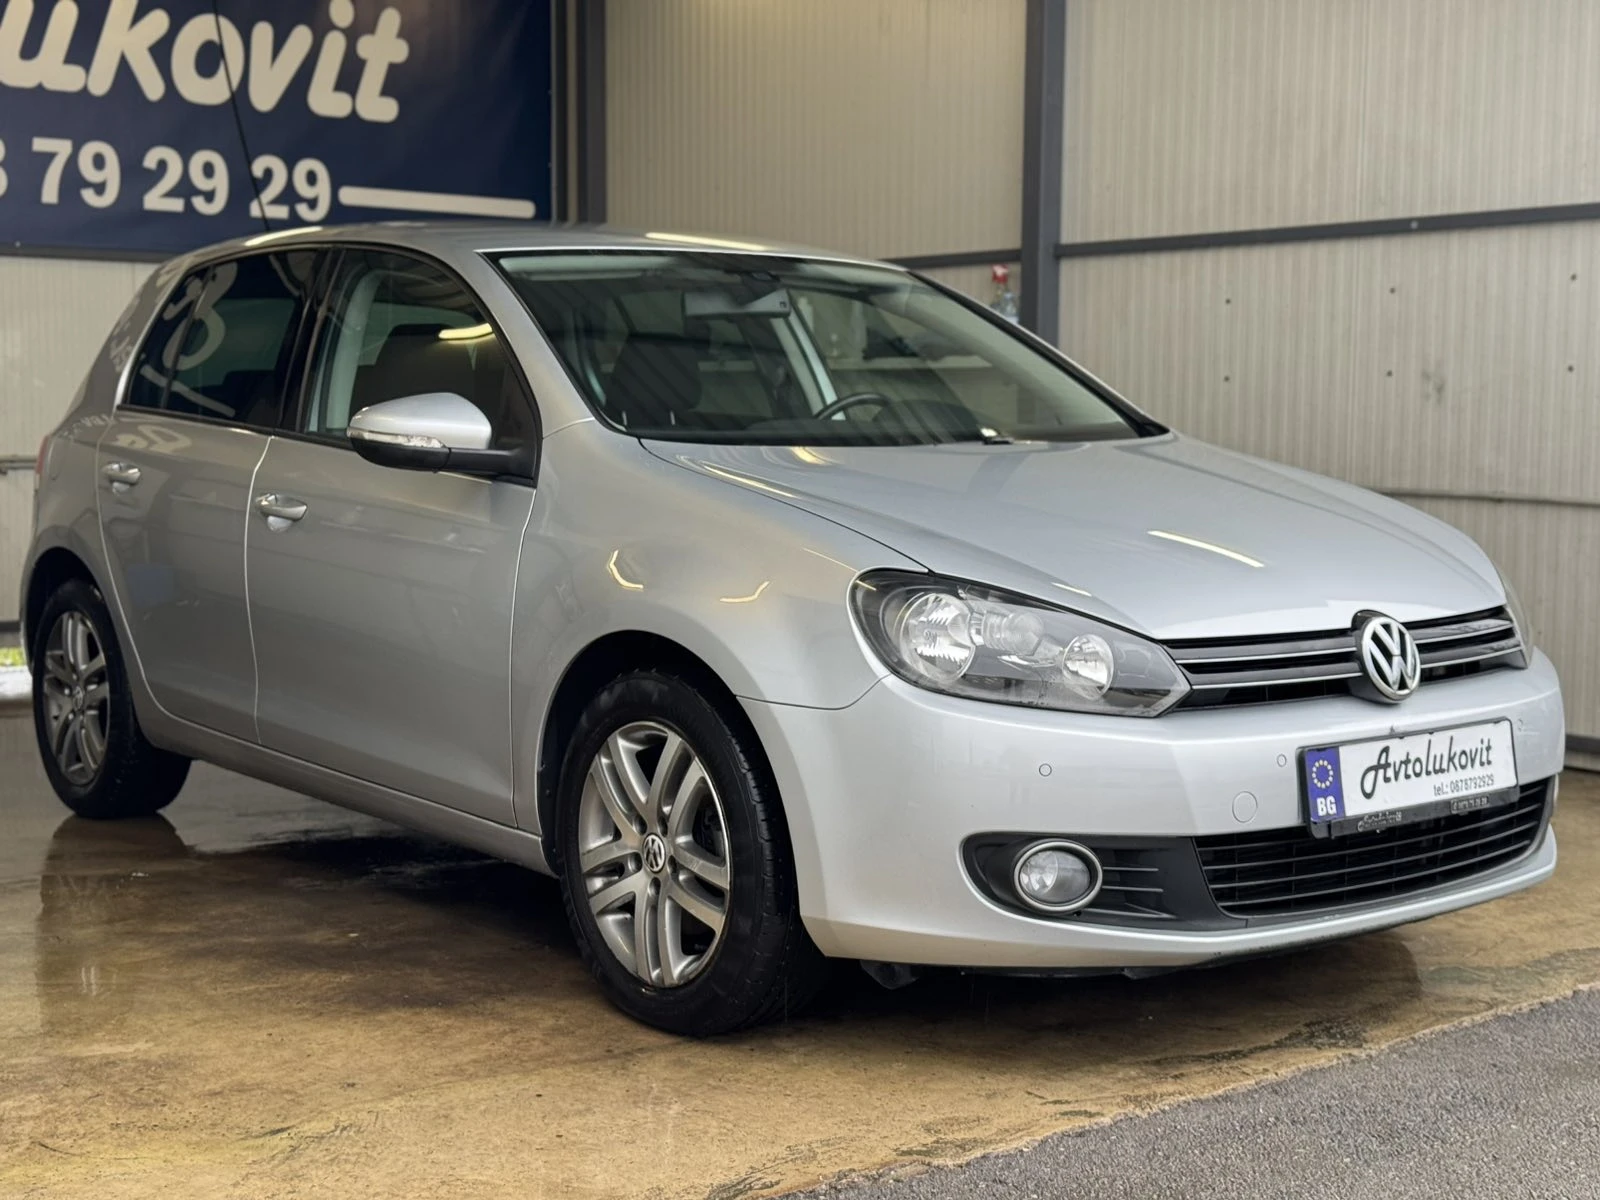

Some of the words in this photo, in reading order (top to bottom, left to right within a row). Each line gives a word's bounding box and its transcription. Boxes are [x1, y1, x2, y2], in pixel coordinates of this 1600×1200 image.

[32, 136, 121, 208] 79
[142, 146, 229, 216] 29
[250, 155, 332, 222] 29
[1360, 736, 1492, 799] Avtolukovit
[1317, 795, 1337, 817] BG
